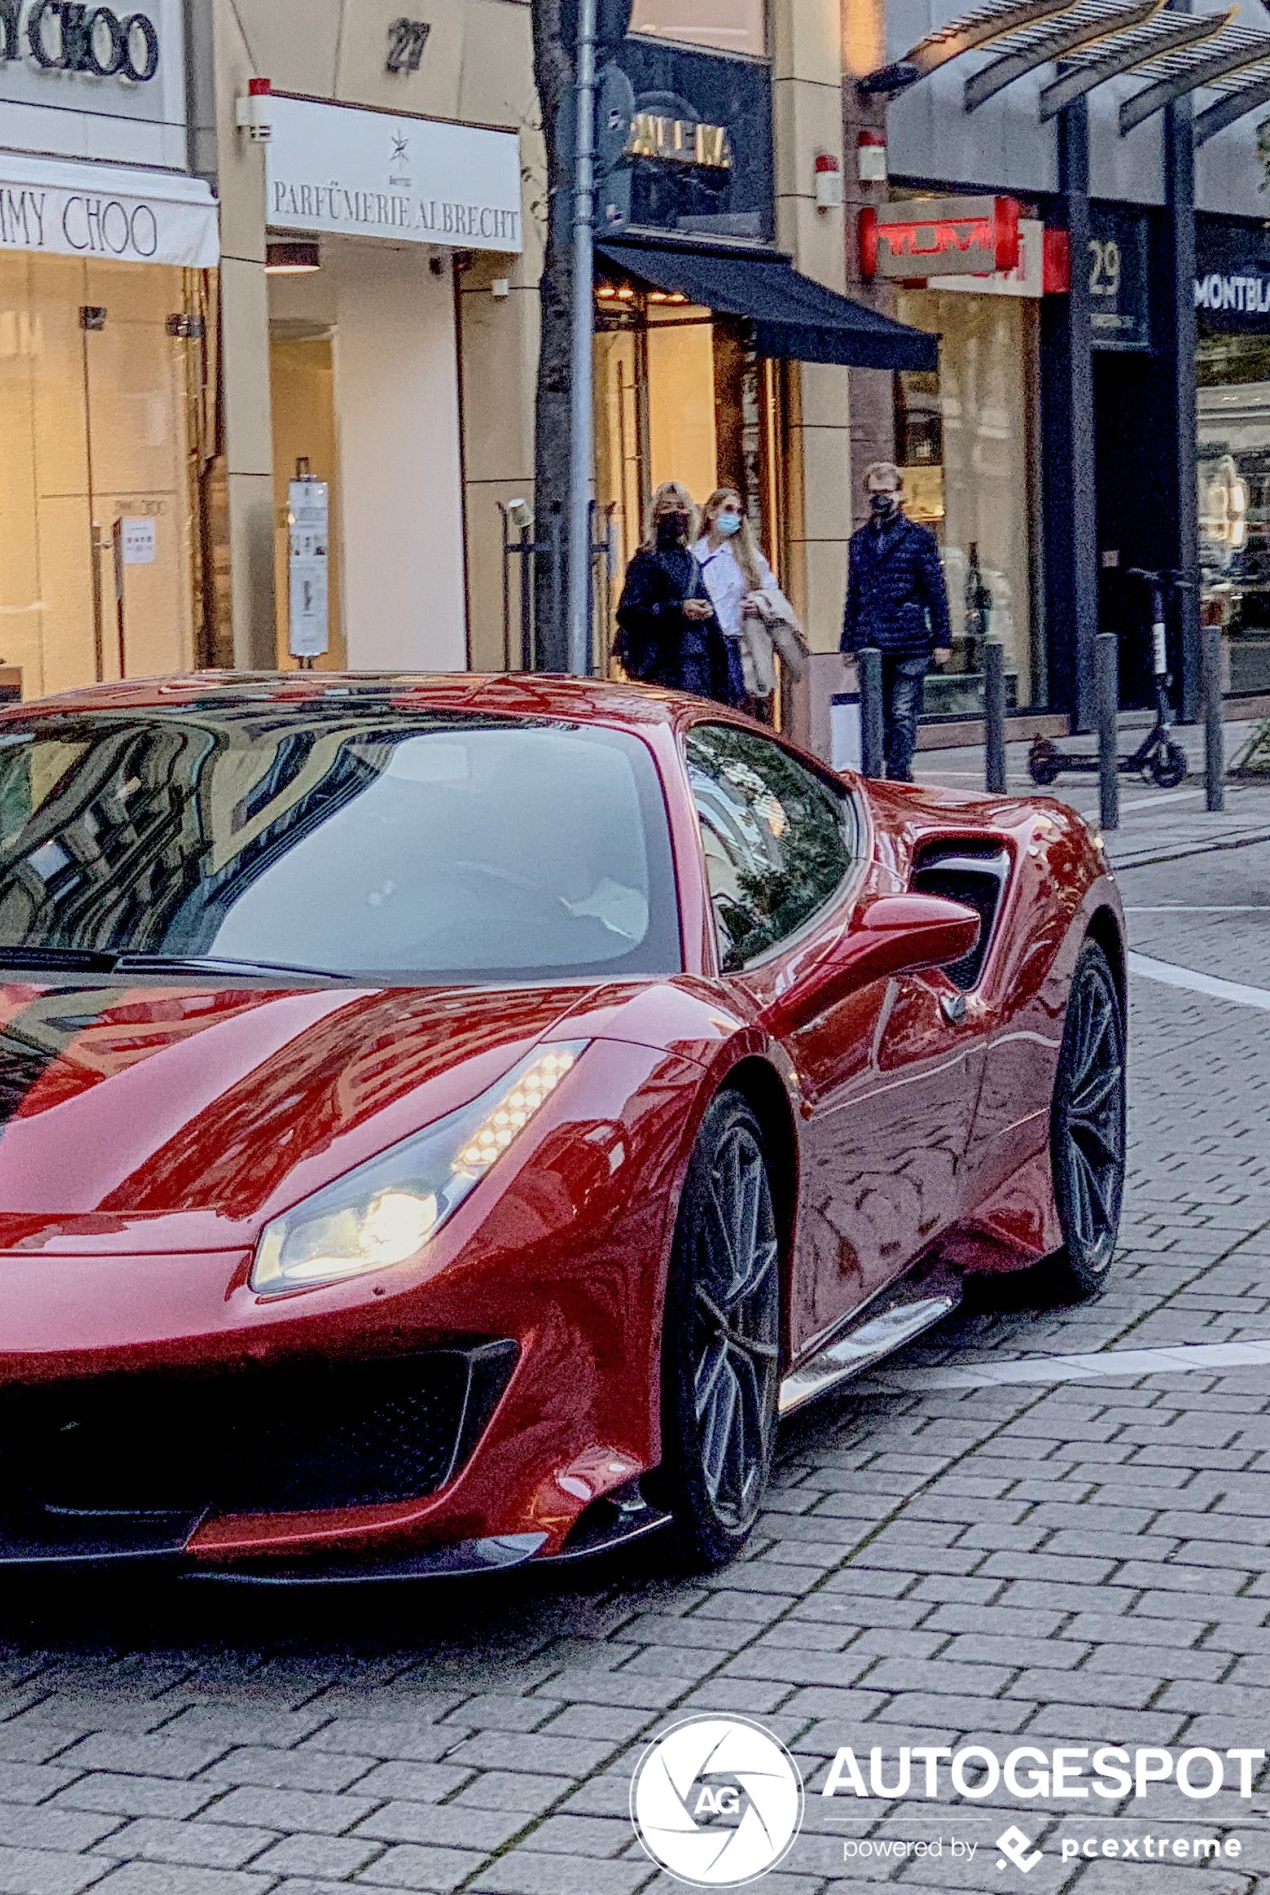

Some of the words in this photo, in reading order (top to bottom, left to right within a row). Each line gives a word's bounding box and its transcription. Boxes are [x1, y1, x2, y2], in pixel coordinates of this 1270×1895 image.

[30, 0, 159, 81] CHOO
[386, 17, 431, 72] 27
[62, 196, 157, 256] CHOO
[274, 180, 411, 228] PARFÜMERIE
[416, 199, 518, 240] ALBRECHT
[1088, 240, 1119, 295] 29
